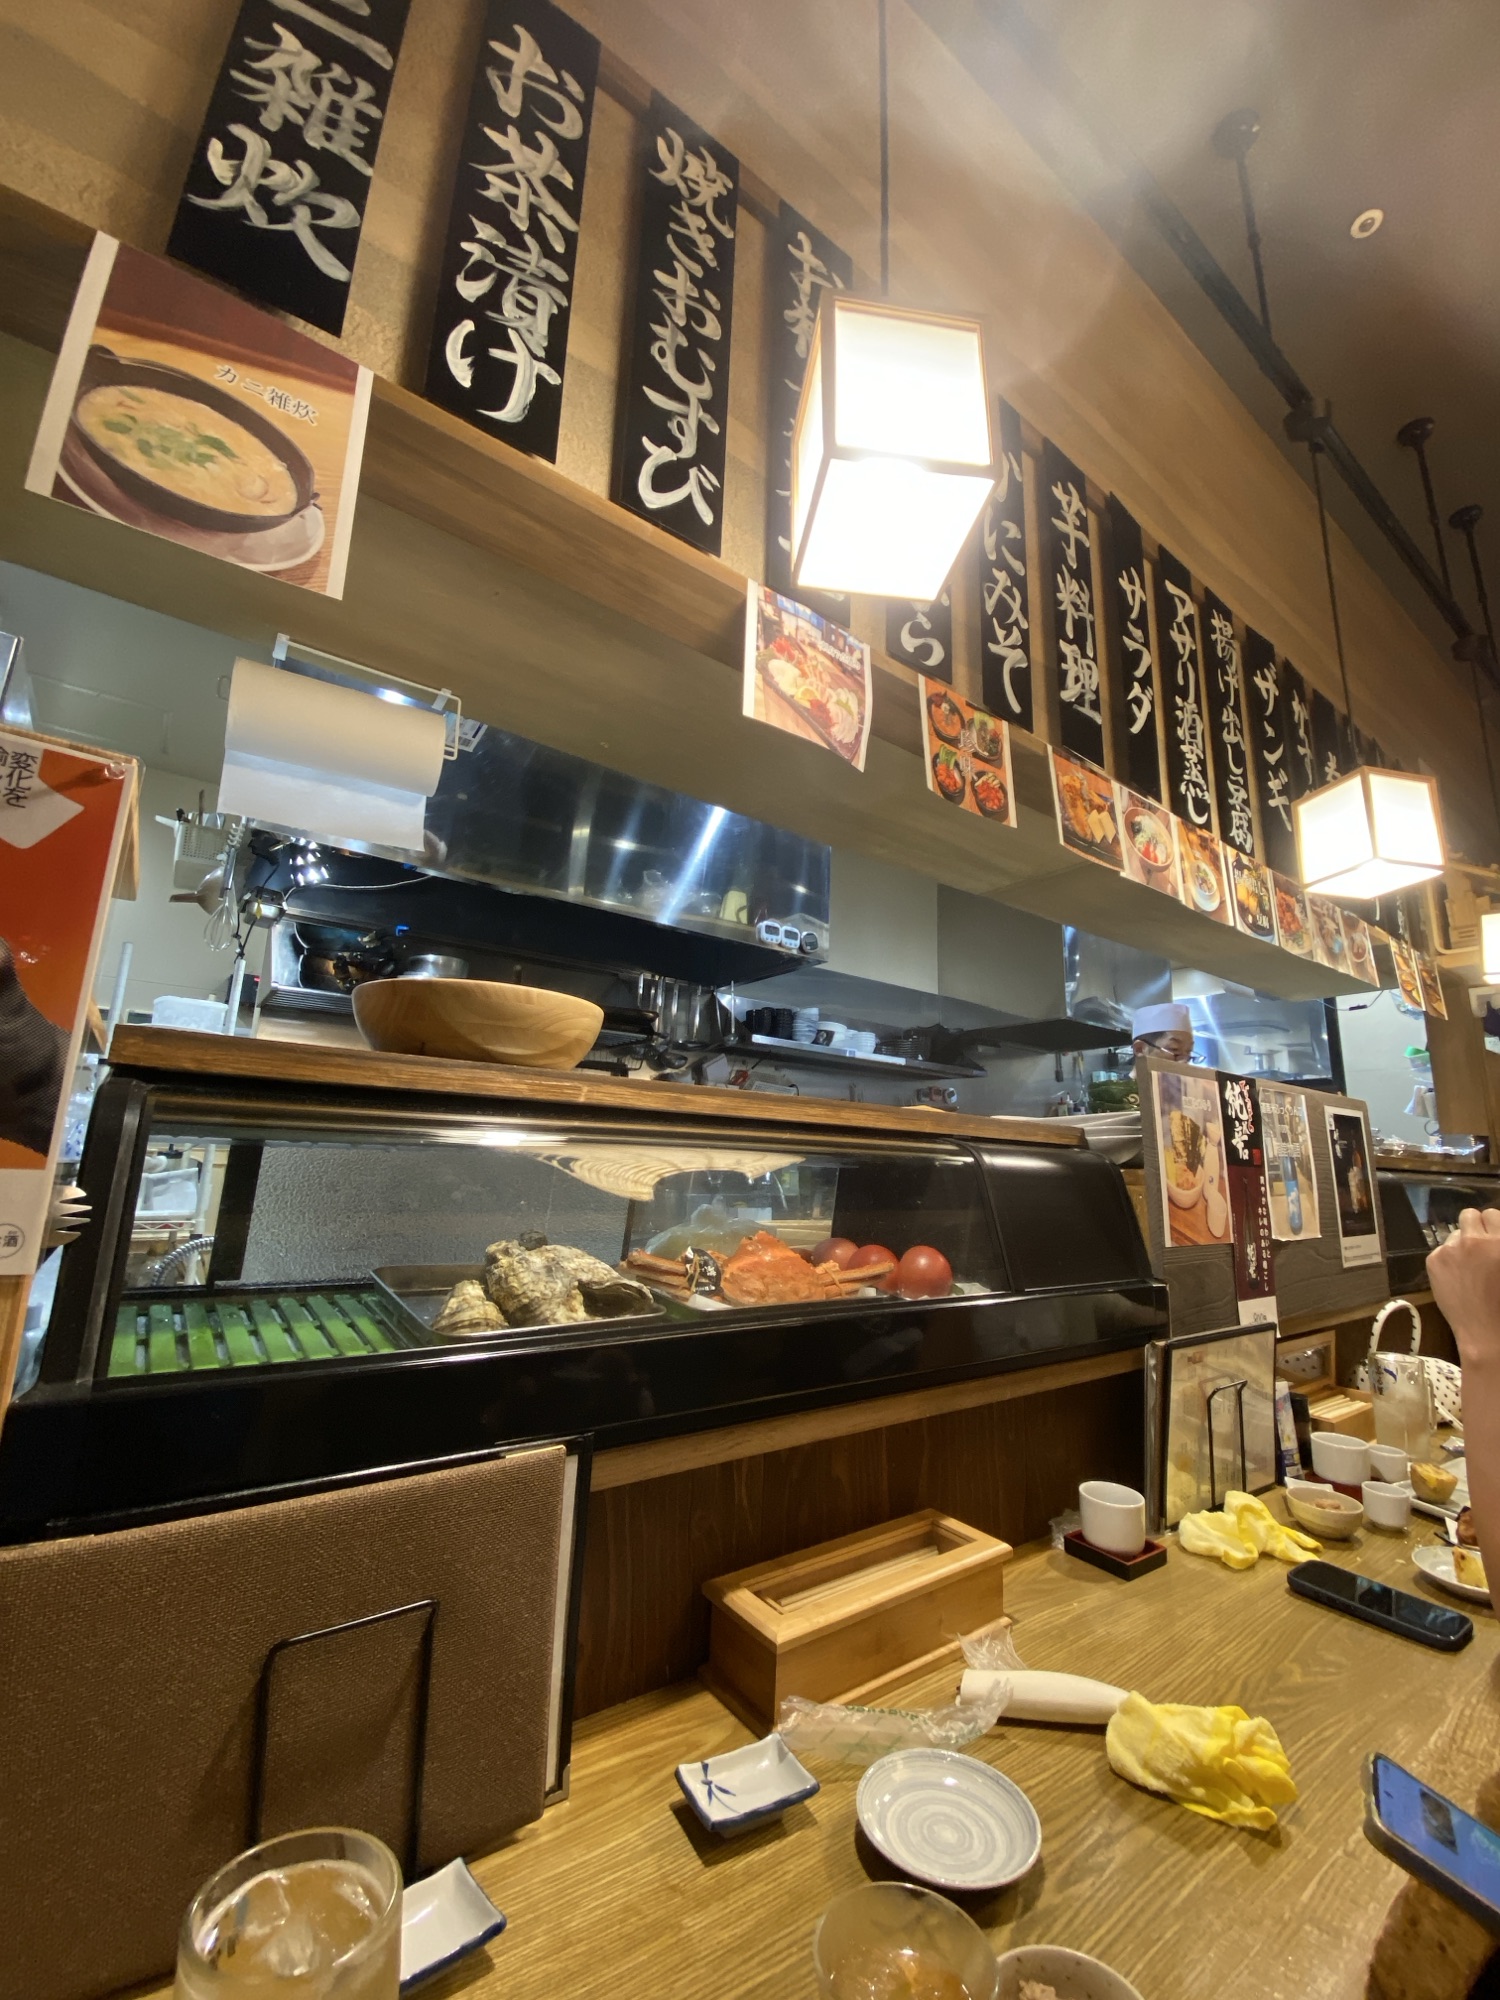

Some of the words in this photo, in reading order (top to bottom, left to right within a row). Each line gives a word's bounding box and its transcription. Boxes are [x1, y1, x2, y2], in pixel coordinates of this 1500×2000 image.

[455, 24, 585, 423] お茶漬け
[217, 366, 317, 426] カニ雑炊
[638, 127, 735, 525] 焼きおむすび
[1118, 566, 1153, 734] サラダ
[1164, 579, 1211, 824] アサリ酒蒸し
[2, 751, 39, 809] 変化を
[1253, 662, 1293, 832] ザンギ
